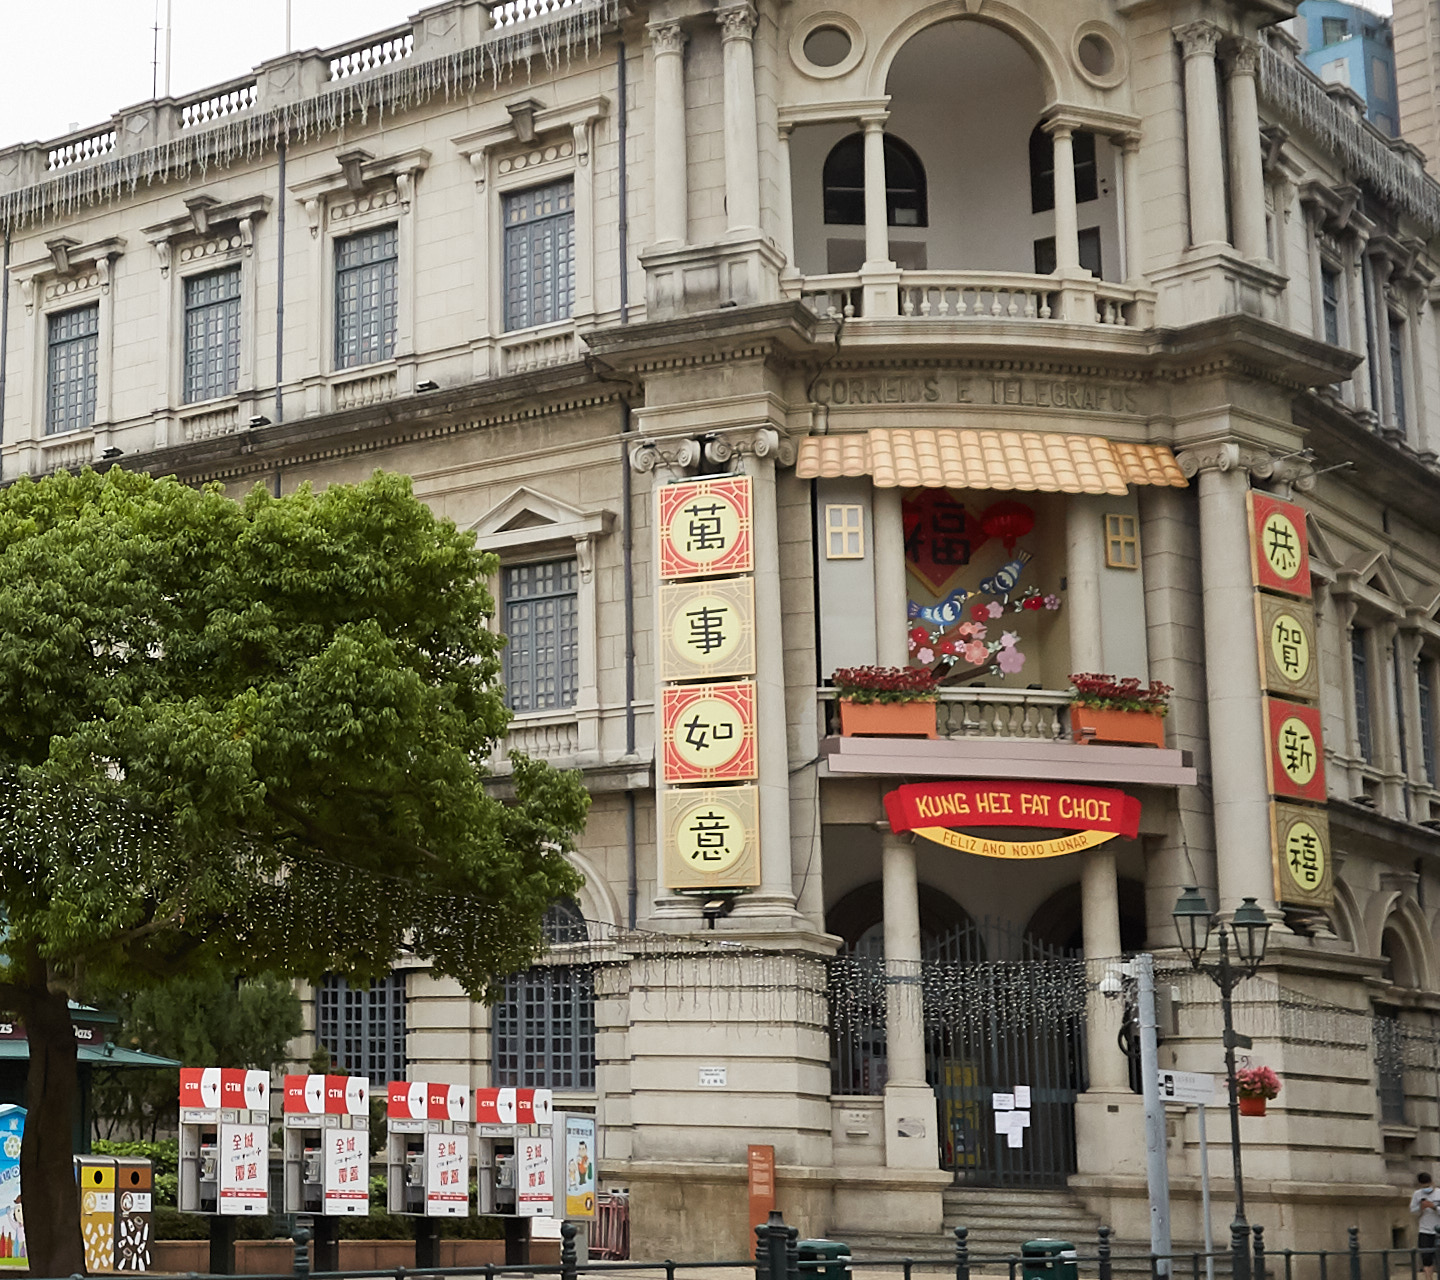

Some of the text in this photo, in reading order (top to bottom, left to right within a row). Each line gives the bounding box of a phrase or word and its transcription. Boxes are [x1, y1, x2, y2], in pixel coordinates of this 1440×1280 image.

[684, 504, 733, 861] 萬事如意
[1268, 523, 1319, 884] 恭賀新禧
[915, 792, 1112, 822] KUNG HEI FAT CHOI
[942, 831, 1089, 857] FELIZ ANO NOVO LUNAR
[225, 1082, 241, 1092] CTM
[328, 1088, 343, 1098] CTM
